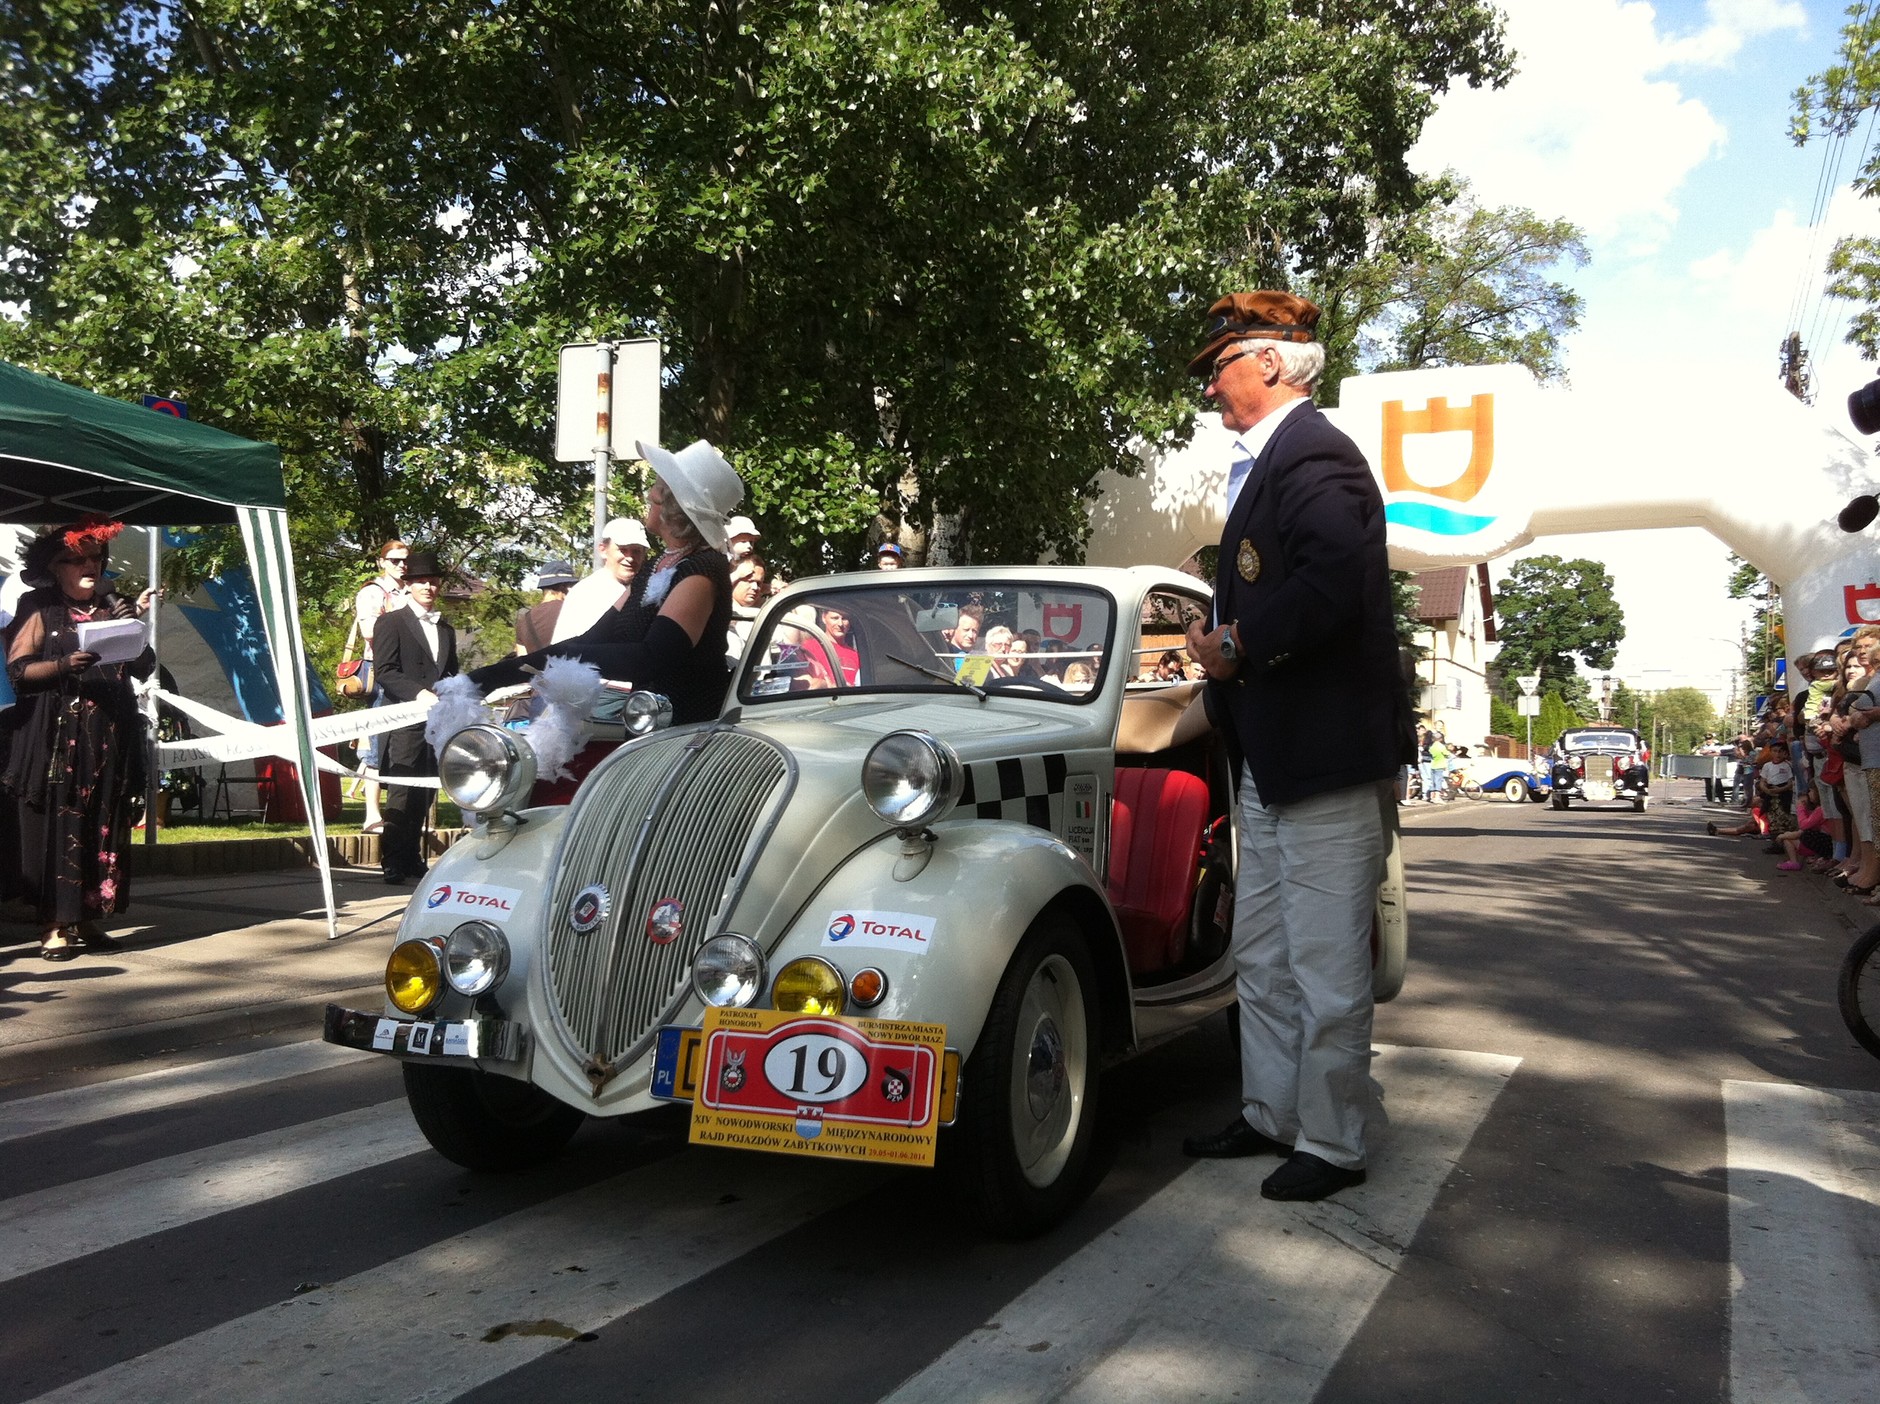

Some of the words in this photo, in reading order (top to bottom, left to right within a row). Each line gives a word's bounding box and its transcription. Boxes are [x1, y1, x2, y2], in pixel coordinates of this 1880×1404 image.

[456, 891, 511, 910] TOTAL
[861, 921, 926, 941] TOTAL
[720, 1010, 758, 1019] PATRONAT
[719, 1019, 763, 1028] HONOROWY
[858, 1021, 911, 1032] BURMISTRZA
[912, 1025, 944, 1035] MIASTA
[867, 1031, 894, 1040] NOWY
[895, 1031, 921, 1041] DWÓR
[657, 1070, 672, 1085] PL
[785, 1045, 847, 1095] 19
[694, 1114, 712, 1124] XIV
[715, 1117, 793, 1133] NOWODWORSKI
[826, 1127, 933, 1145] MIĘDZYNARODOWY
[699, 1131, 725, 1142] RAJD
[726, 1133, 781, 1148] POJAZDÓW
[783, 1139, 867, 1155] ZABYTKOWYCH
